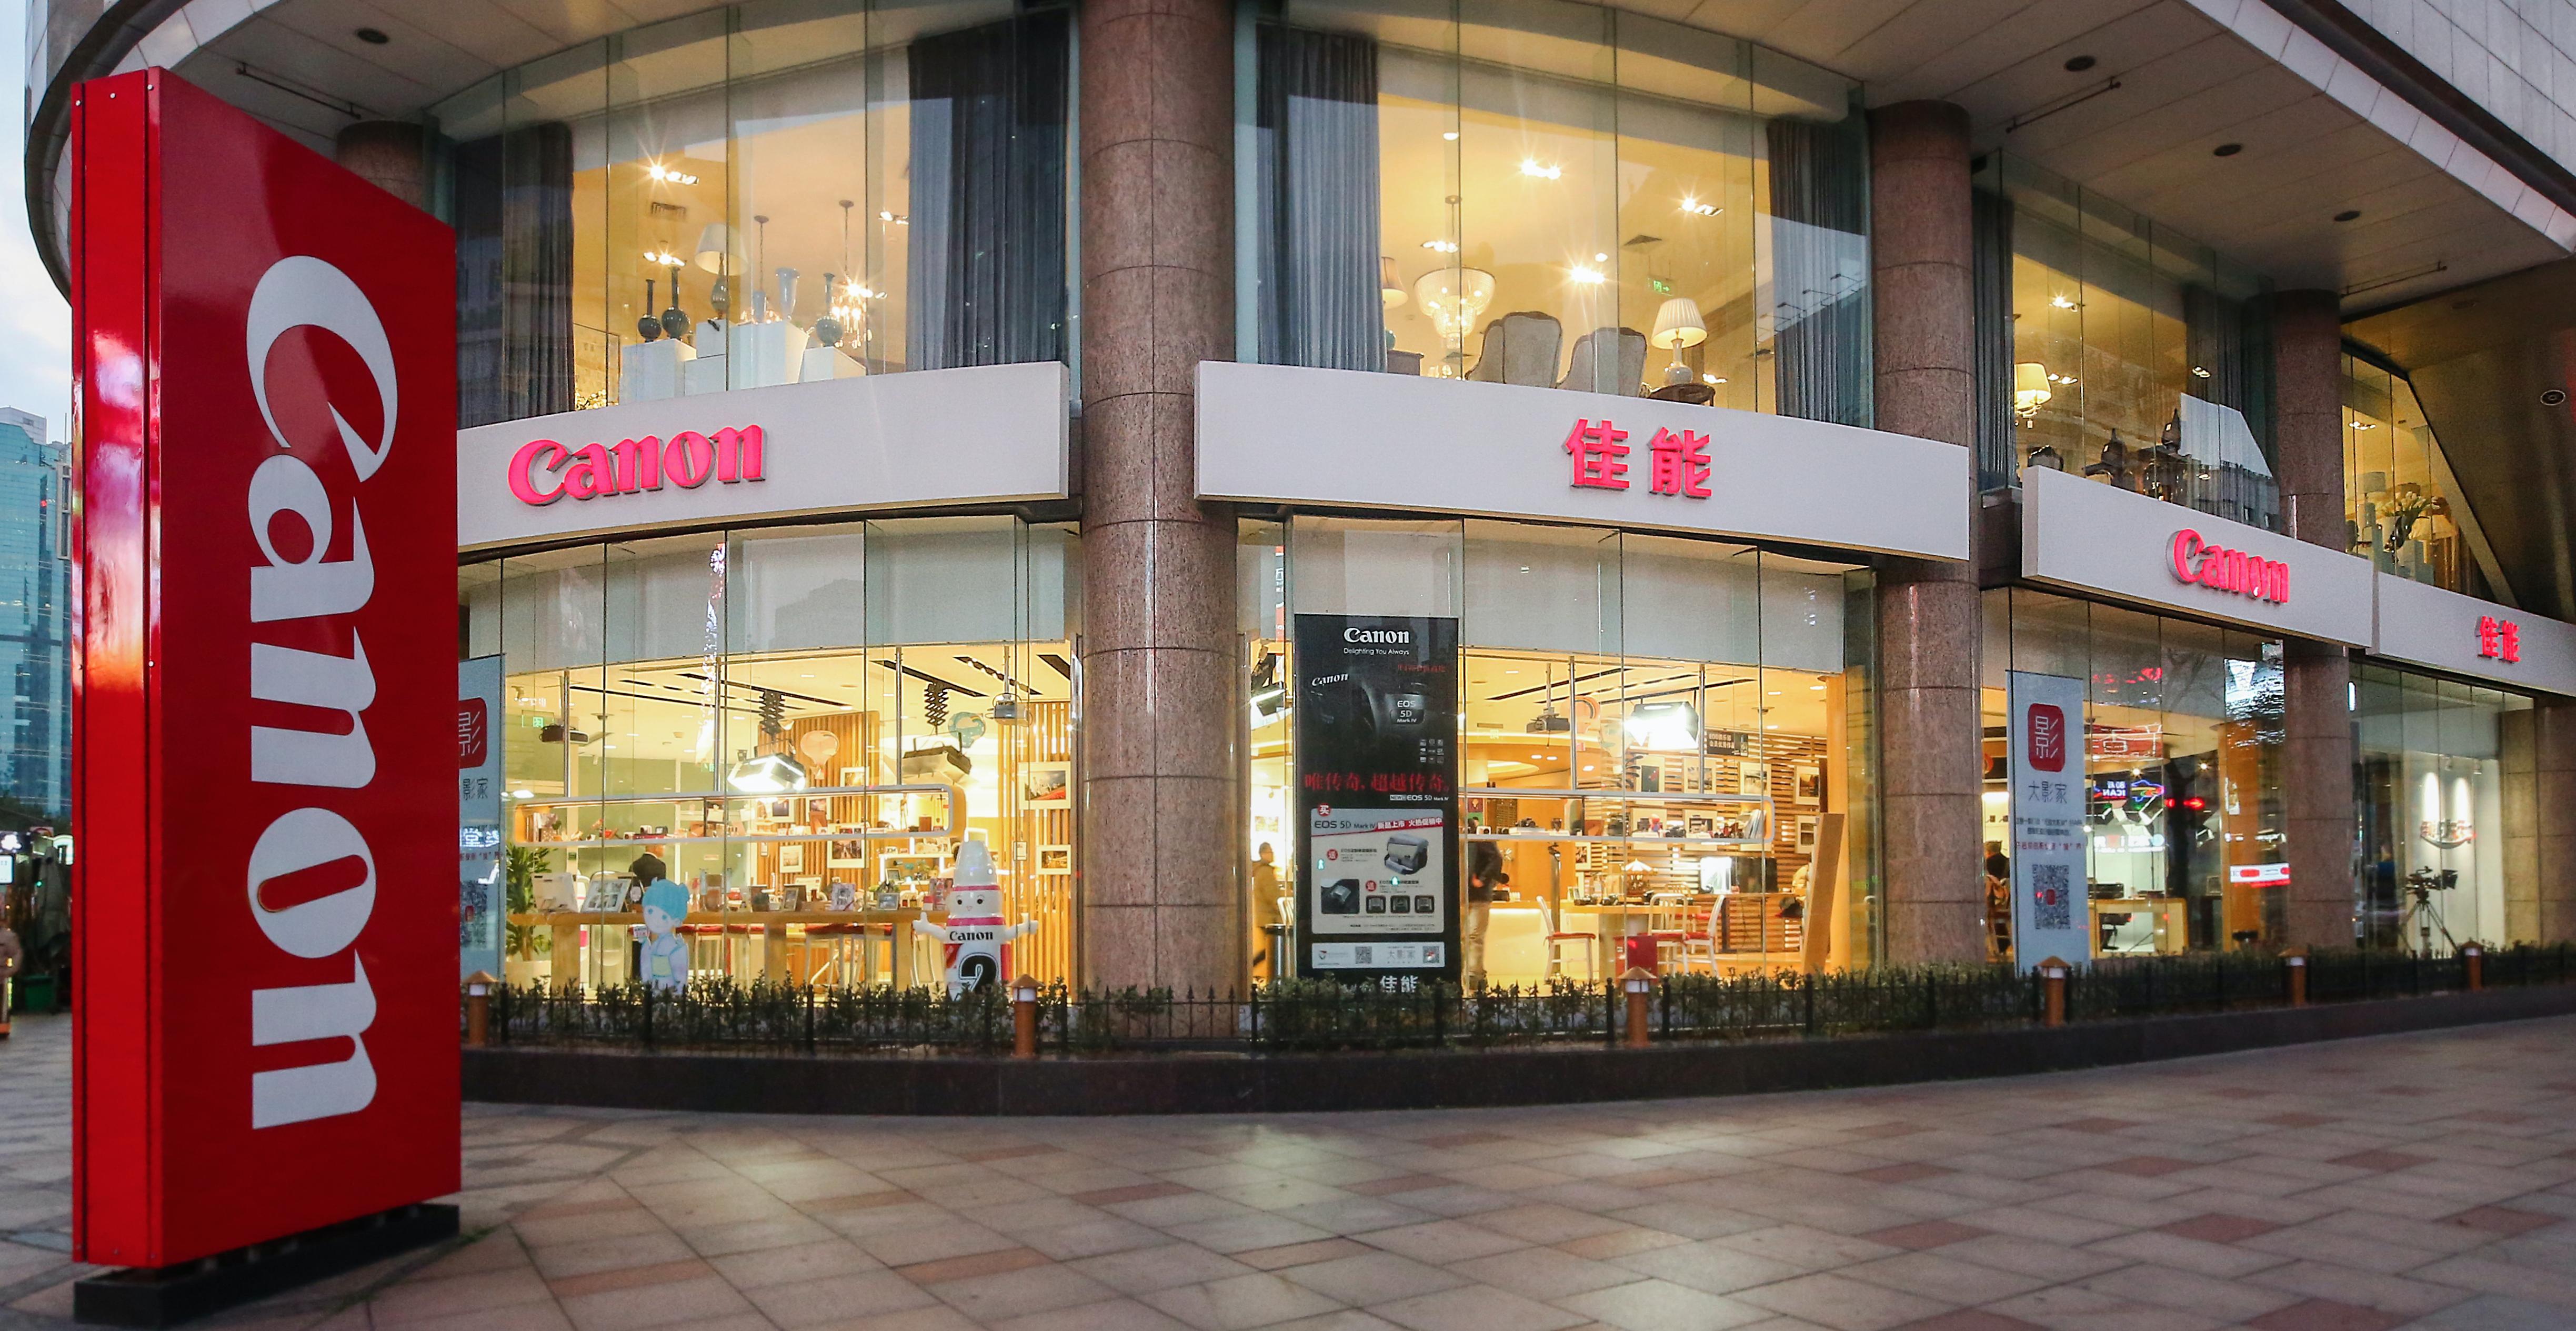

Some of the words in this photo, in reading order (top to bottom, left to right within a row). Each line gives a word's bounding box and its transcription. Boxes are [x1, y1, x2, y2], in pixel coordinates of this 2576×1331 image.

[507, 424, 767, 506] Canon
[1565, 418, 1713, 499] 佳能
[2169, 528, 2290, 604] Canon
[1344, 627, 1409, 643] Canon
[2479, 616, 2521, 663] 佳能
[246, 255, 399, 1130] Canon
[1311, 673, 1349, 686] Canon
[2034, 716, 2058, 759] 影
[2028, 780, 2067, 804] 大影家
[1319, 805, 1330, 815] 买
[949, 931, 993, 941] Canon
[1380, 975, 1418, 993] 佳能
